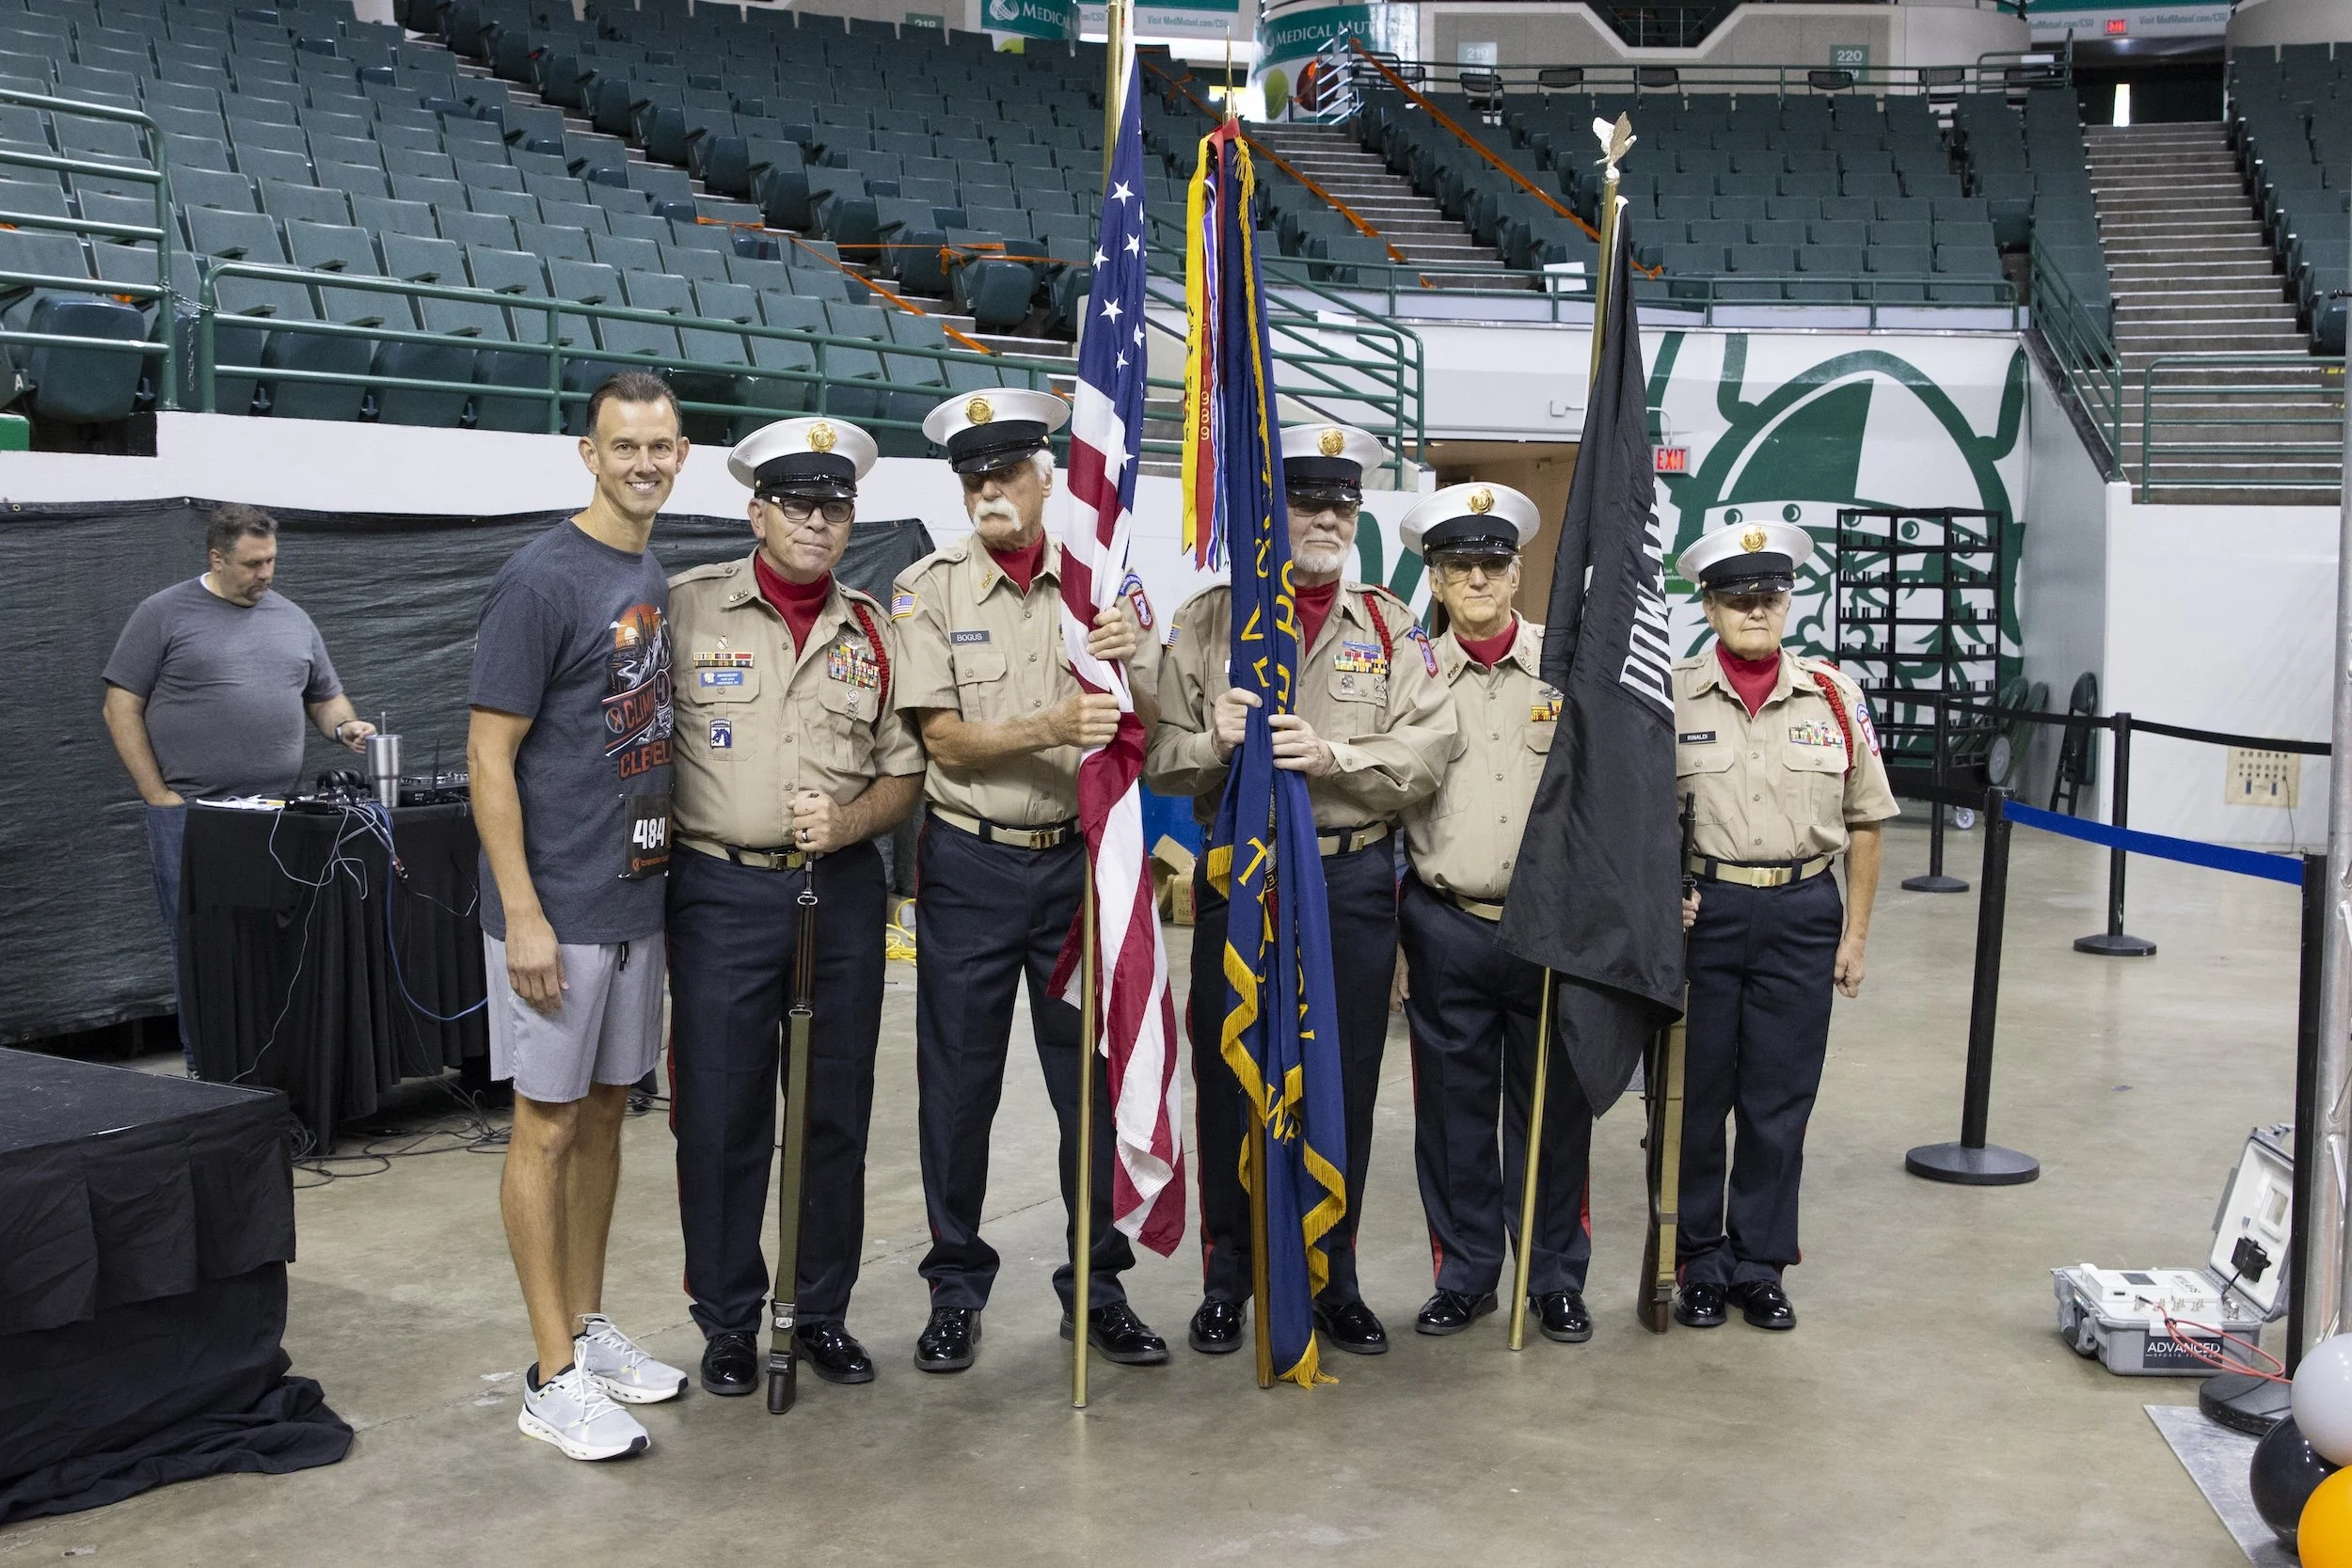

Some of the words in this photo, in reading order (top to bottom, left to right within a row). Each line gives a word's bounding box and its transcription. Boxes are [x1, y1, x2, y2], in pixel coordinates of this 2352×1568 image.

[1276, 24, 1333, 46] MEDICAL
[1837, 50, 1863, 62] 220
[14, 373, 24, 391] A
[1657, 448, 1686, 469] EXIT
[956, 632, 983, 641] BOGUS
[1687, 733, 1708, 741] RINALDI
[632, 816, 666, 849] 484
[2147, 1342, 2220, 1354] ADVANCED
